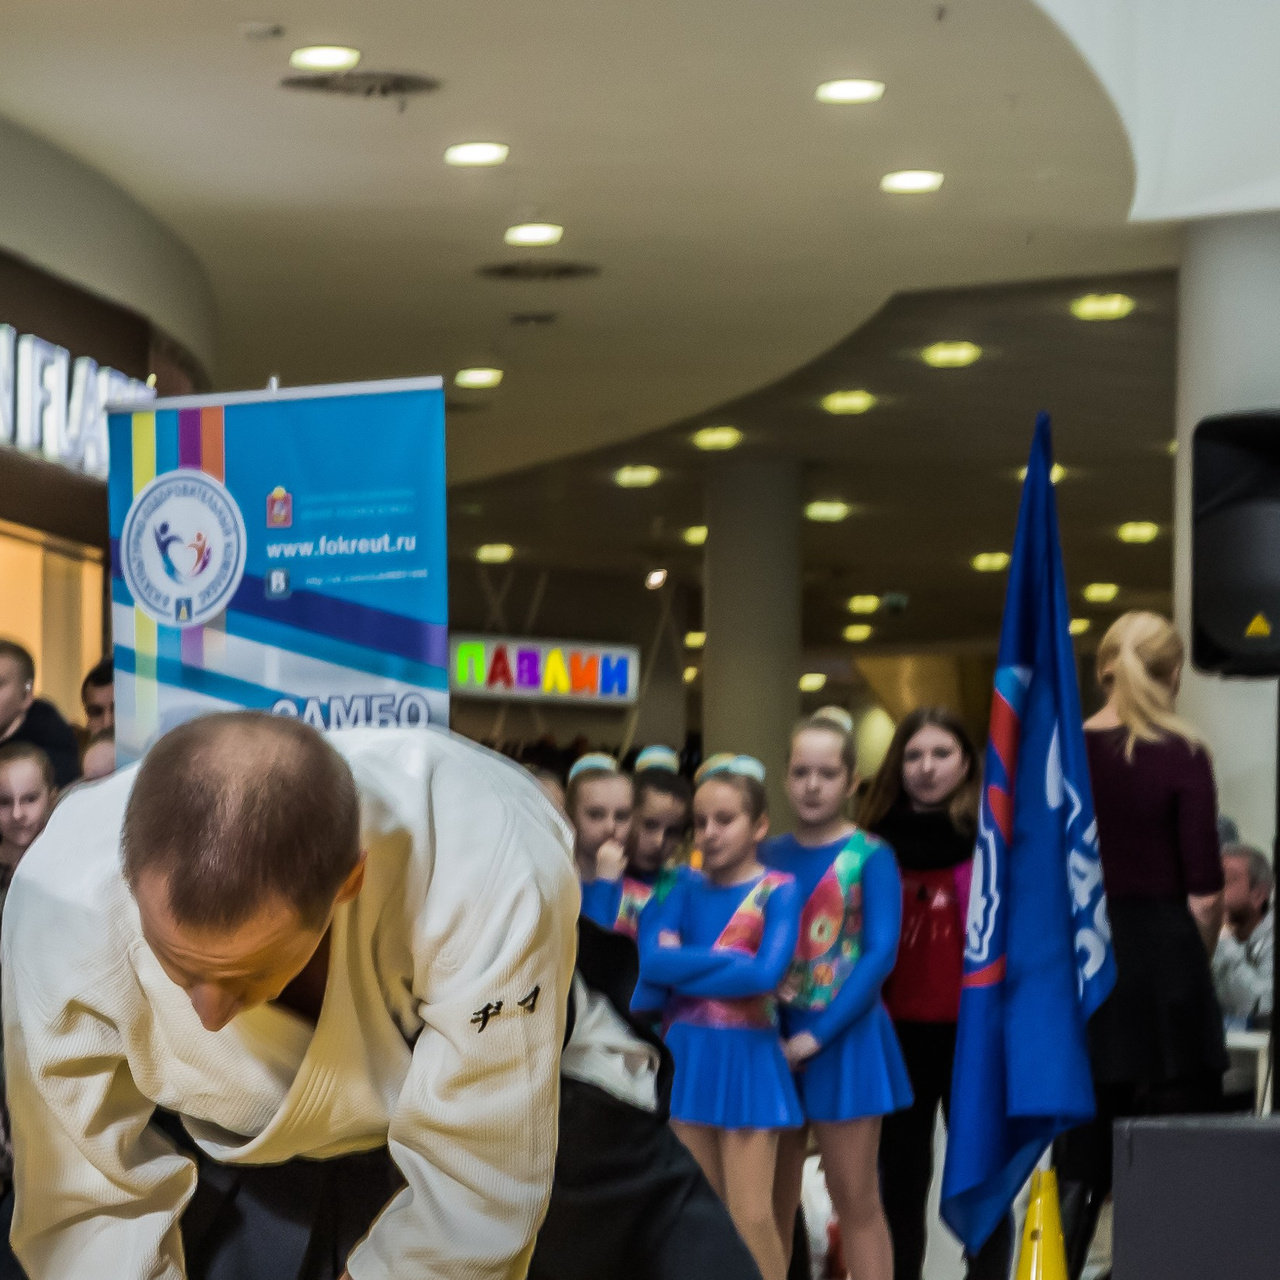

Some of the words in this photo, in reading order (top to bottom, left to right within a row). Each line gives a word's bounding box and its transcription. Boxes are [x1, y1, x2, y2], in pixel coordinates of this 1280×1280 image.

[18, 333, 158, 480] FLA
[267, 533, 416, 558] www.fokreut.ru
[456, 641, 630, 696] ПАВЛИН
